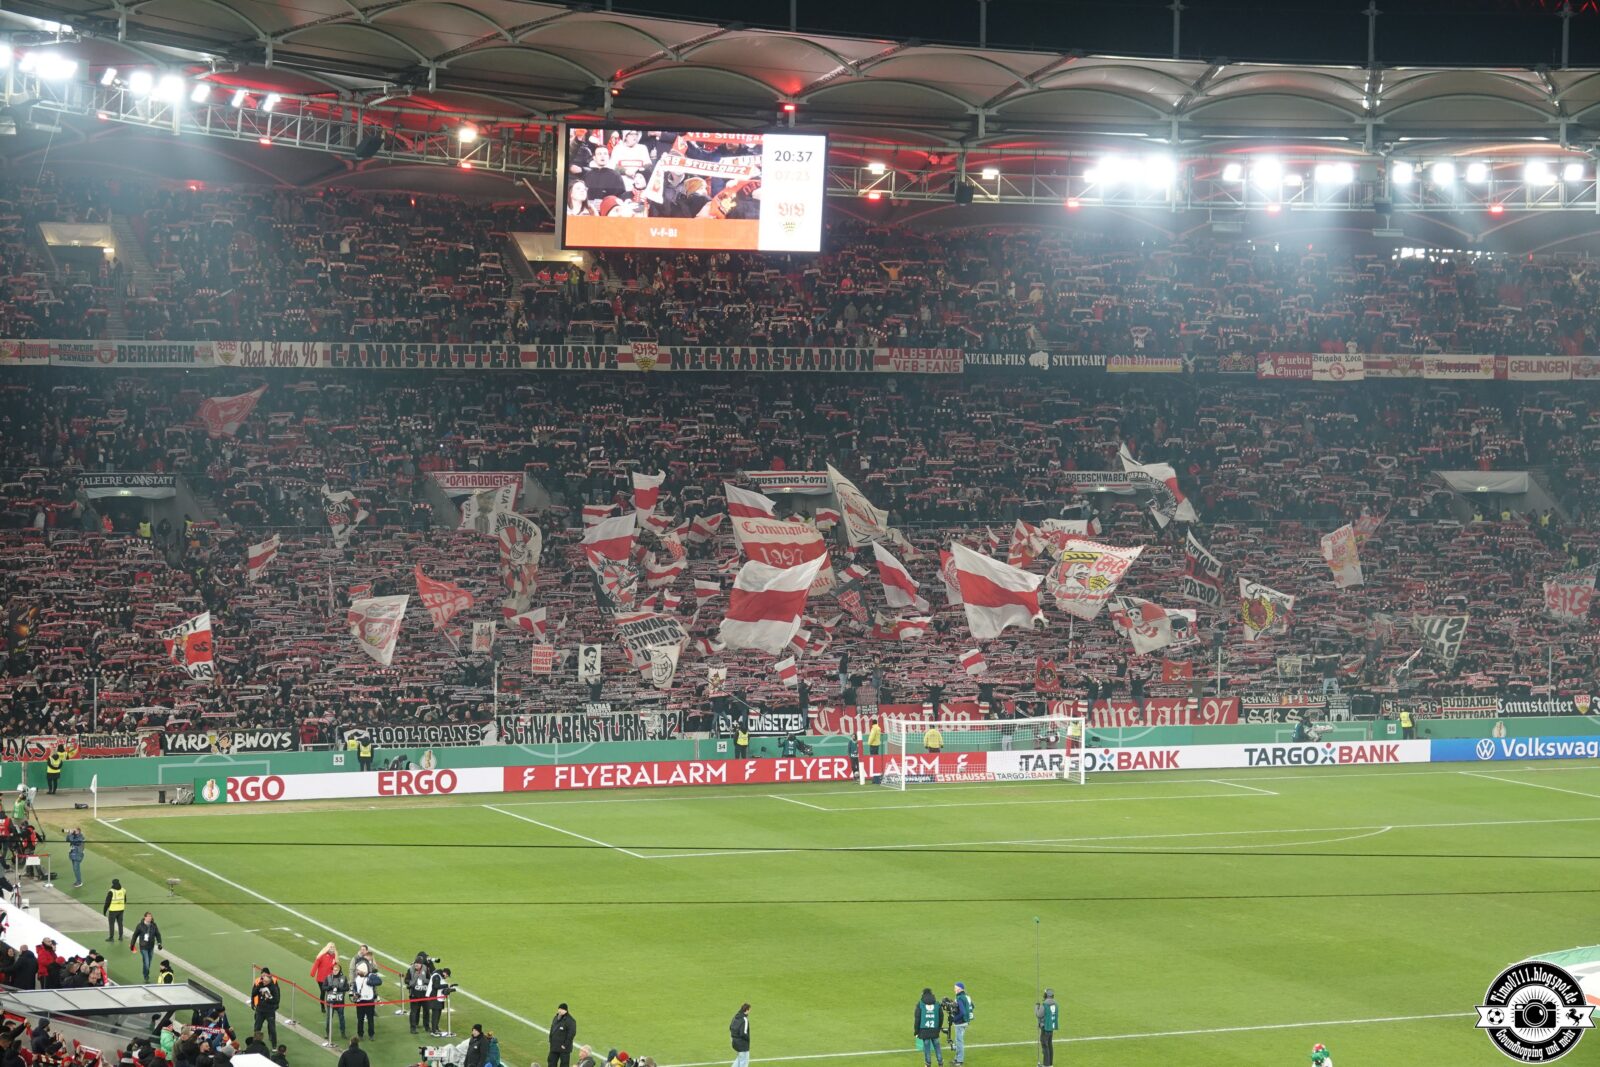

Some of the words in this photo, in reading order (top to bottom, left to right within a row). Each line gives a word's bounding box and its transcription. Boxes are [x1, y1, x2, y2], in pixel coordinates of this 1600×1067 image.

[775, 150, 812, 162] 20:37
[117, 345, 195, 363] BERKHEIM
[240, 341, 266, 367] Red
[269, 341, 300, 367] Hots
[302, 342, 318, 367] 96
[330, 343, 521, 369] CANNSTATTER
[536, 345, 618, 370] KURVE
[670, 346, 875, 371] NECKARSTADION
[892, 348, 963, 359] ALBSTADT
[964, 354, 1026, 366] NECKAR-FILS
[1052, 355, 1107, 366] STUTTGART
[893, 360, 964, 372] VFB-FANS
[1510, 360, 1570, 374] GERLINGEN
[125, 476, 174, 485] CANNSTATT
[810, 476, 827, 485] 0711
[1066, 473, 1128, 483] OBERSCHWABEN
[1202, 699, 1233, 726] 97
[1444, 709, 1497, 719] STUTTGART
[1498, 698, 1572, 713] Cannstatter
[367, 725, 482, 744] HOOLIGANS
[504, 713, 646, 745] SCHWABENSTURM
[166, 734, 209, 751] YARD
[235, 732, 292, 749] BWOYS
[1501, 738, 1599, 758] Volkswag
[1117, 751, 1180, 769] BANK
[1245, 747, 1319, 766] TARGO
[1339, 745, 1398, 763] BANK
[378, 769, 457, 796] ERGO
[555, 762, 727, 788] FLYERALARM
[946, 773, 986, 782] STRAUSS
